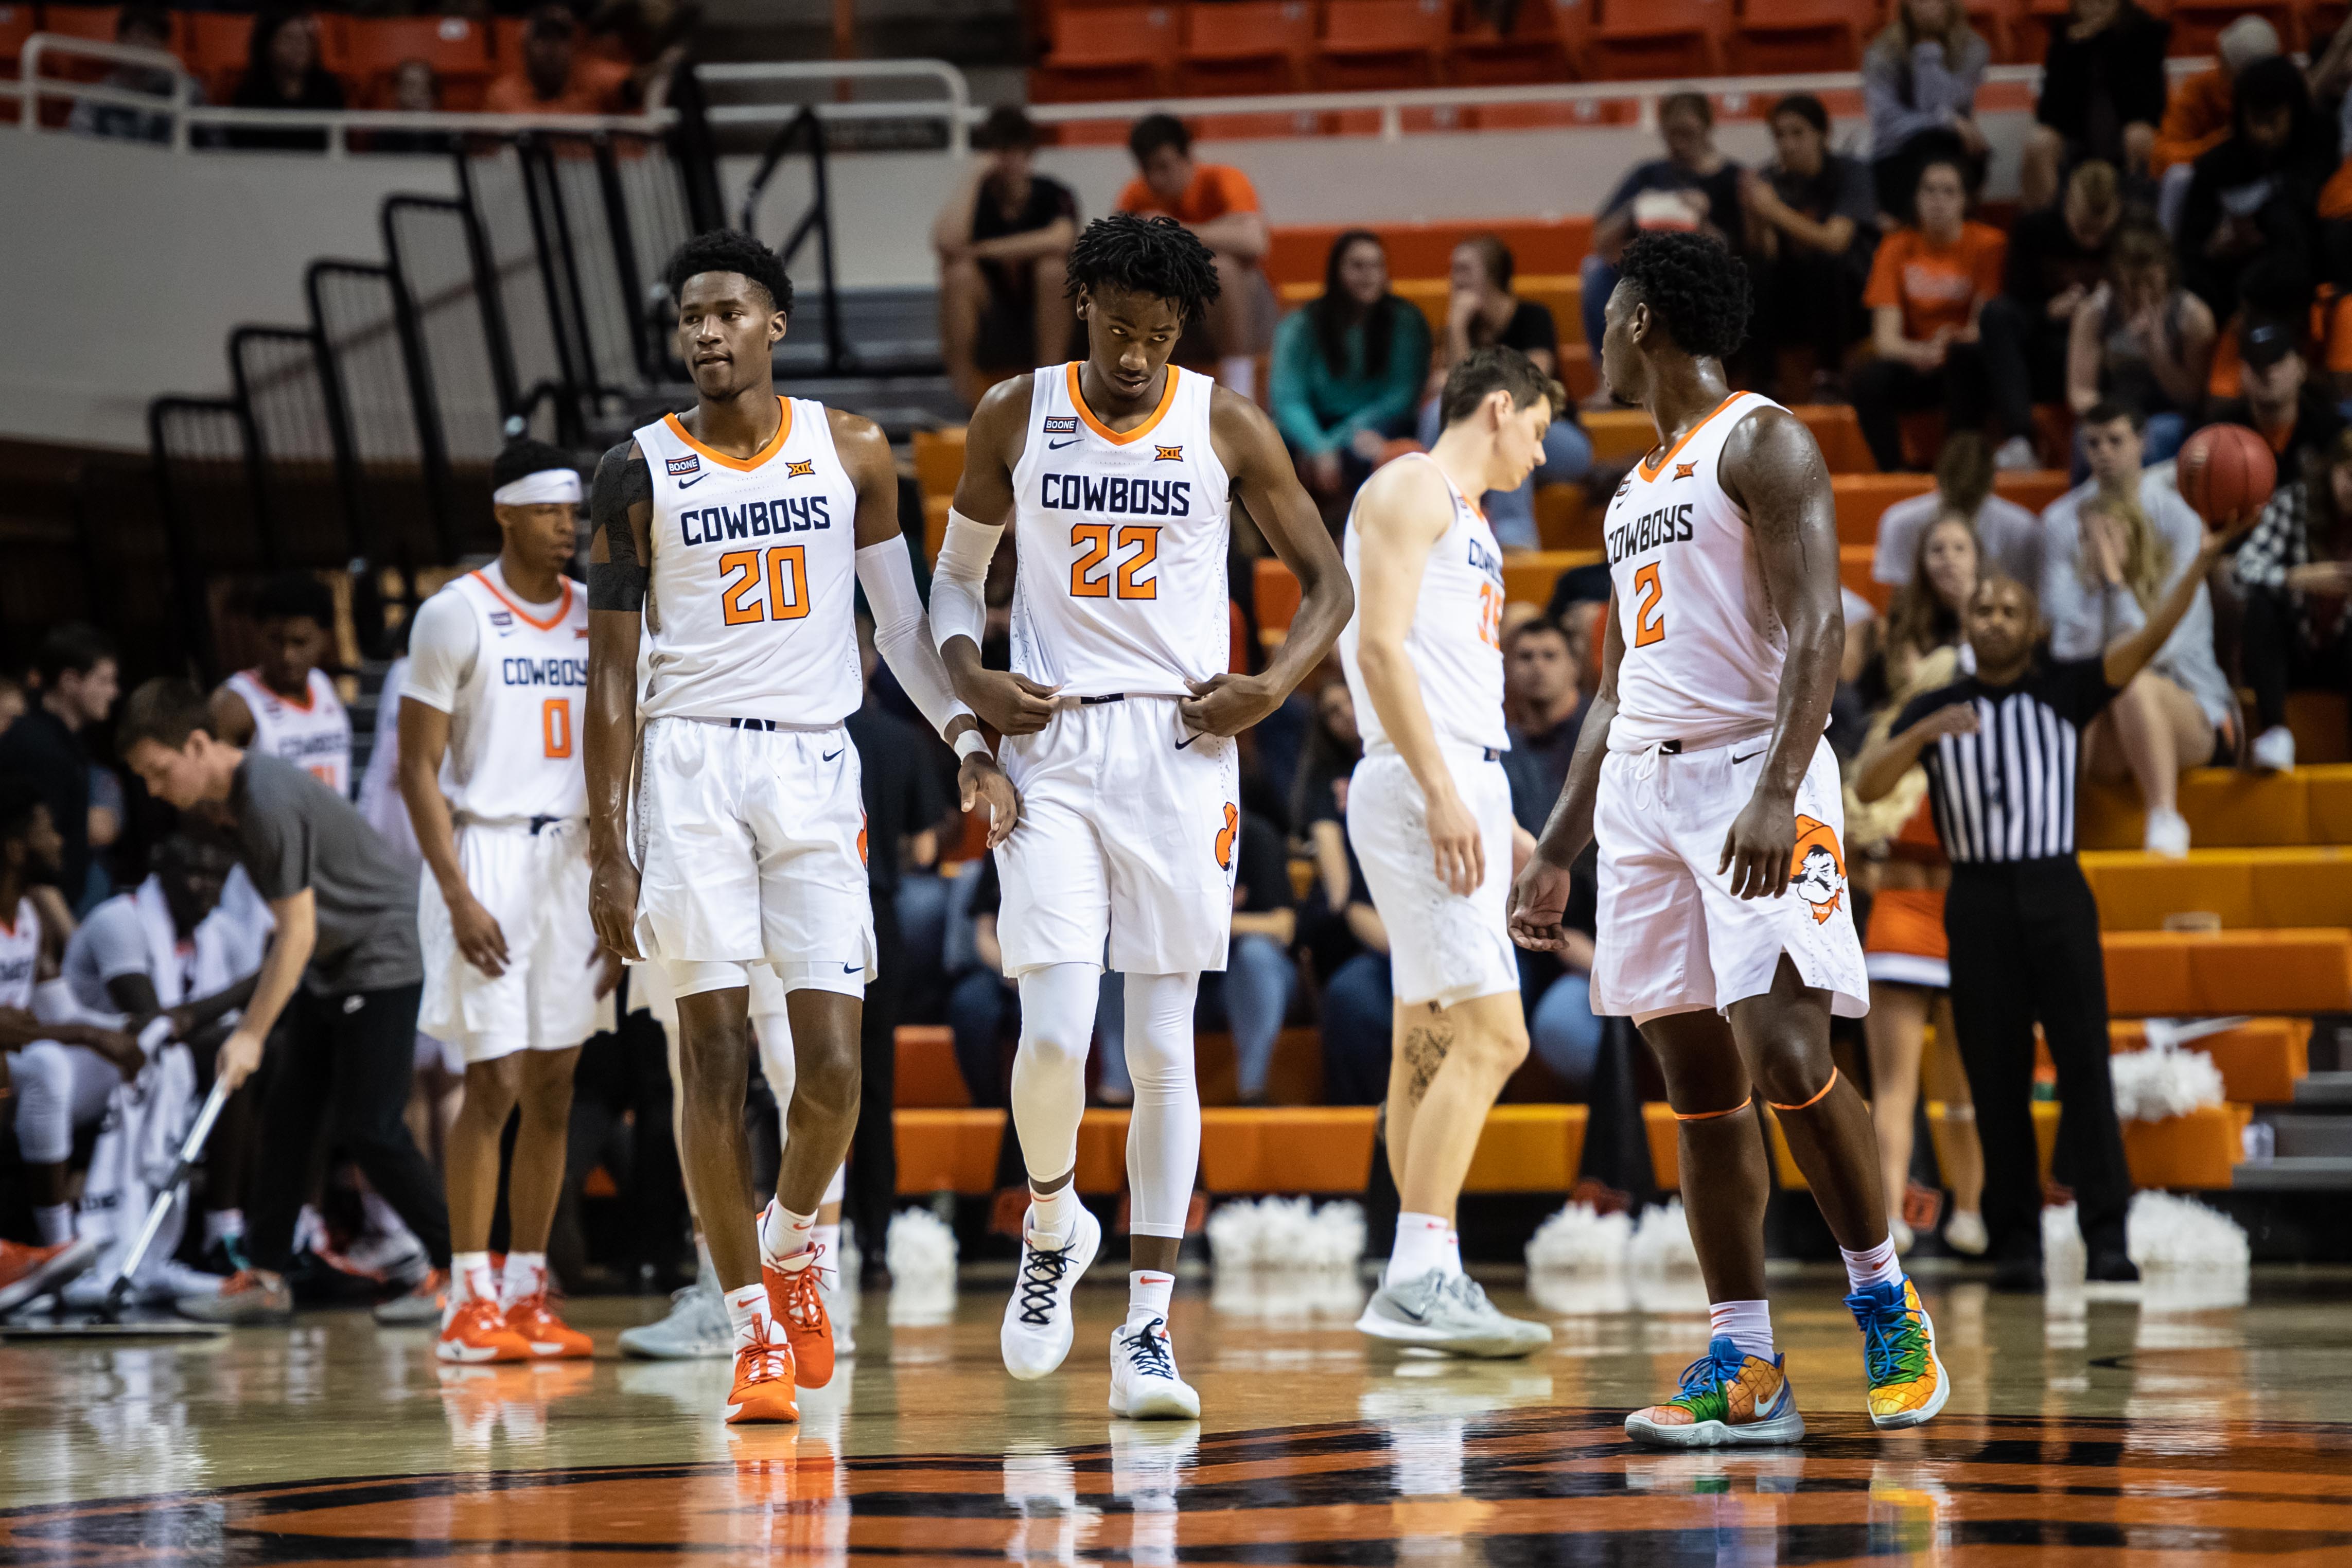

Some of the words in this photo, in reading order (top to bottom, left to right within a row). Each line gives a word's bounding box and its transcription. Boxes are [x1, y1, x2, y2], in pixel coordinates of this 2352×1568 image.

[1046, 420, 1075, 429] BOONE
[669, 459, 697, 471] BOONE
[786, 460, 814, 478] XII
[1154, 446, 1183, 461] XII
[1042, 473, 1190, 516] COWBOYS
[681, 496, 830, 546] COWBOYS
[1608, 503, 1693, 567] COWBOYS
[1070, 523, 1163, 600] 22
[719, 545, 811, 626] 20
[1635, 560, 1665, 648] 2
[503, 658, 587, 685] COWBOY
[543, 698, 572, 759] 0
[1812, 905, 1830, 914] OSU
